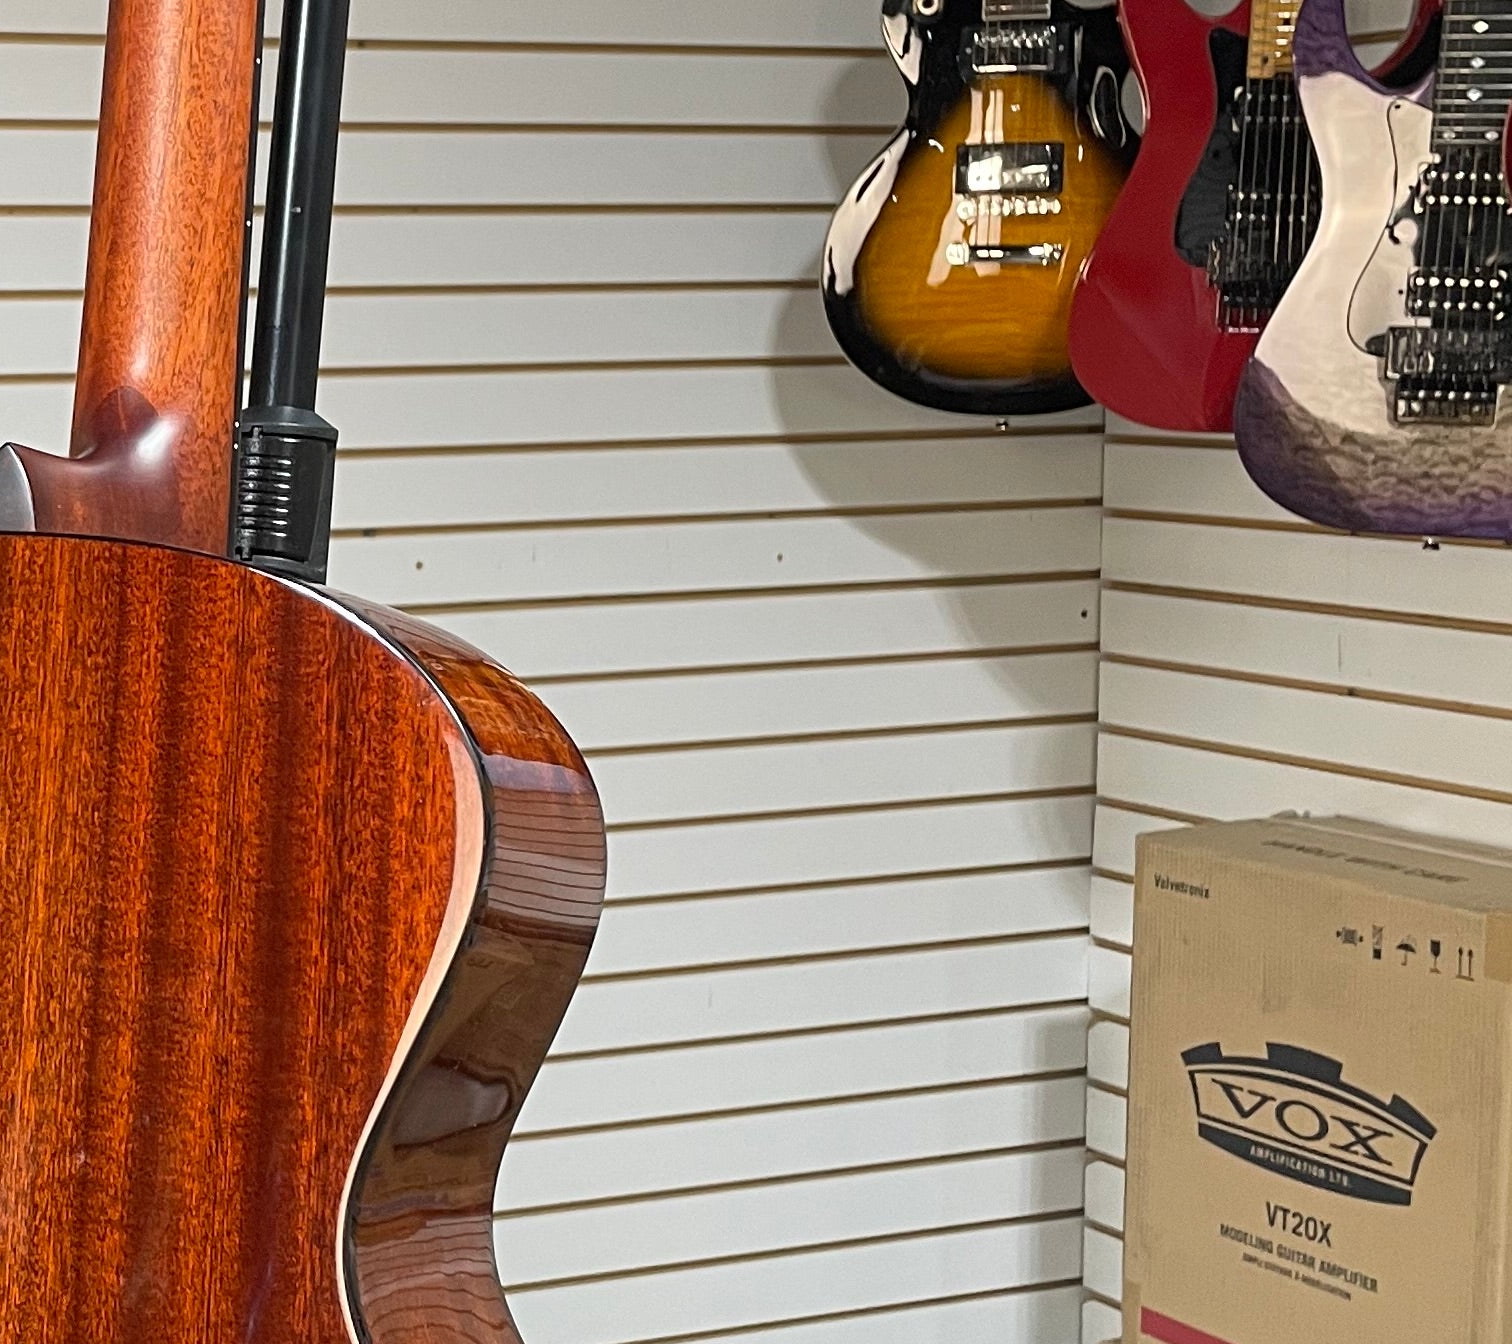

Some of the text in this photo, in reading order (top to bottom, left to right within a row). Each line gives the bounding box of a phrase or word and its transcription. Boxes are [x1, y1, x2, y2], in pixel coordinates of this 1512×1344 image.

[1211, 1077, 1394, 1167] VOX
[1248, 1143, 1326, 1180] AMPLIFICATION
[1265, 1201, 1333, 1248] VT20X
[1220, 1223, 1274, 1254] MODELING
[1276, 1243, 1316, 1270] GUITAR
[1319, 1259, 1379, 1293] AMPLIFIER
